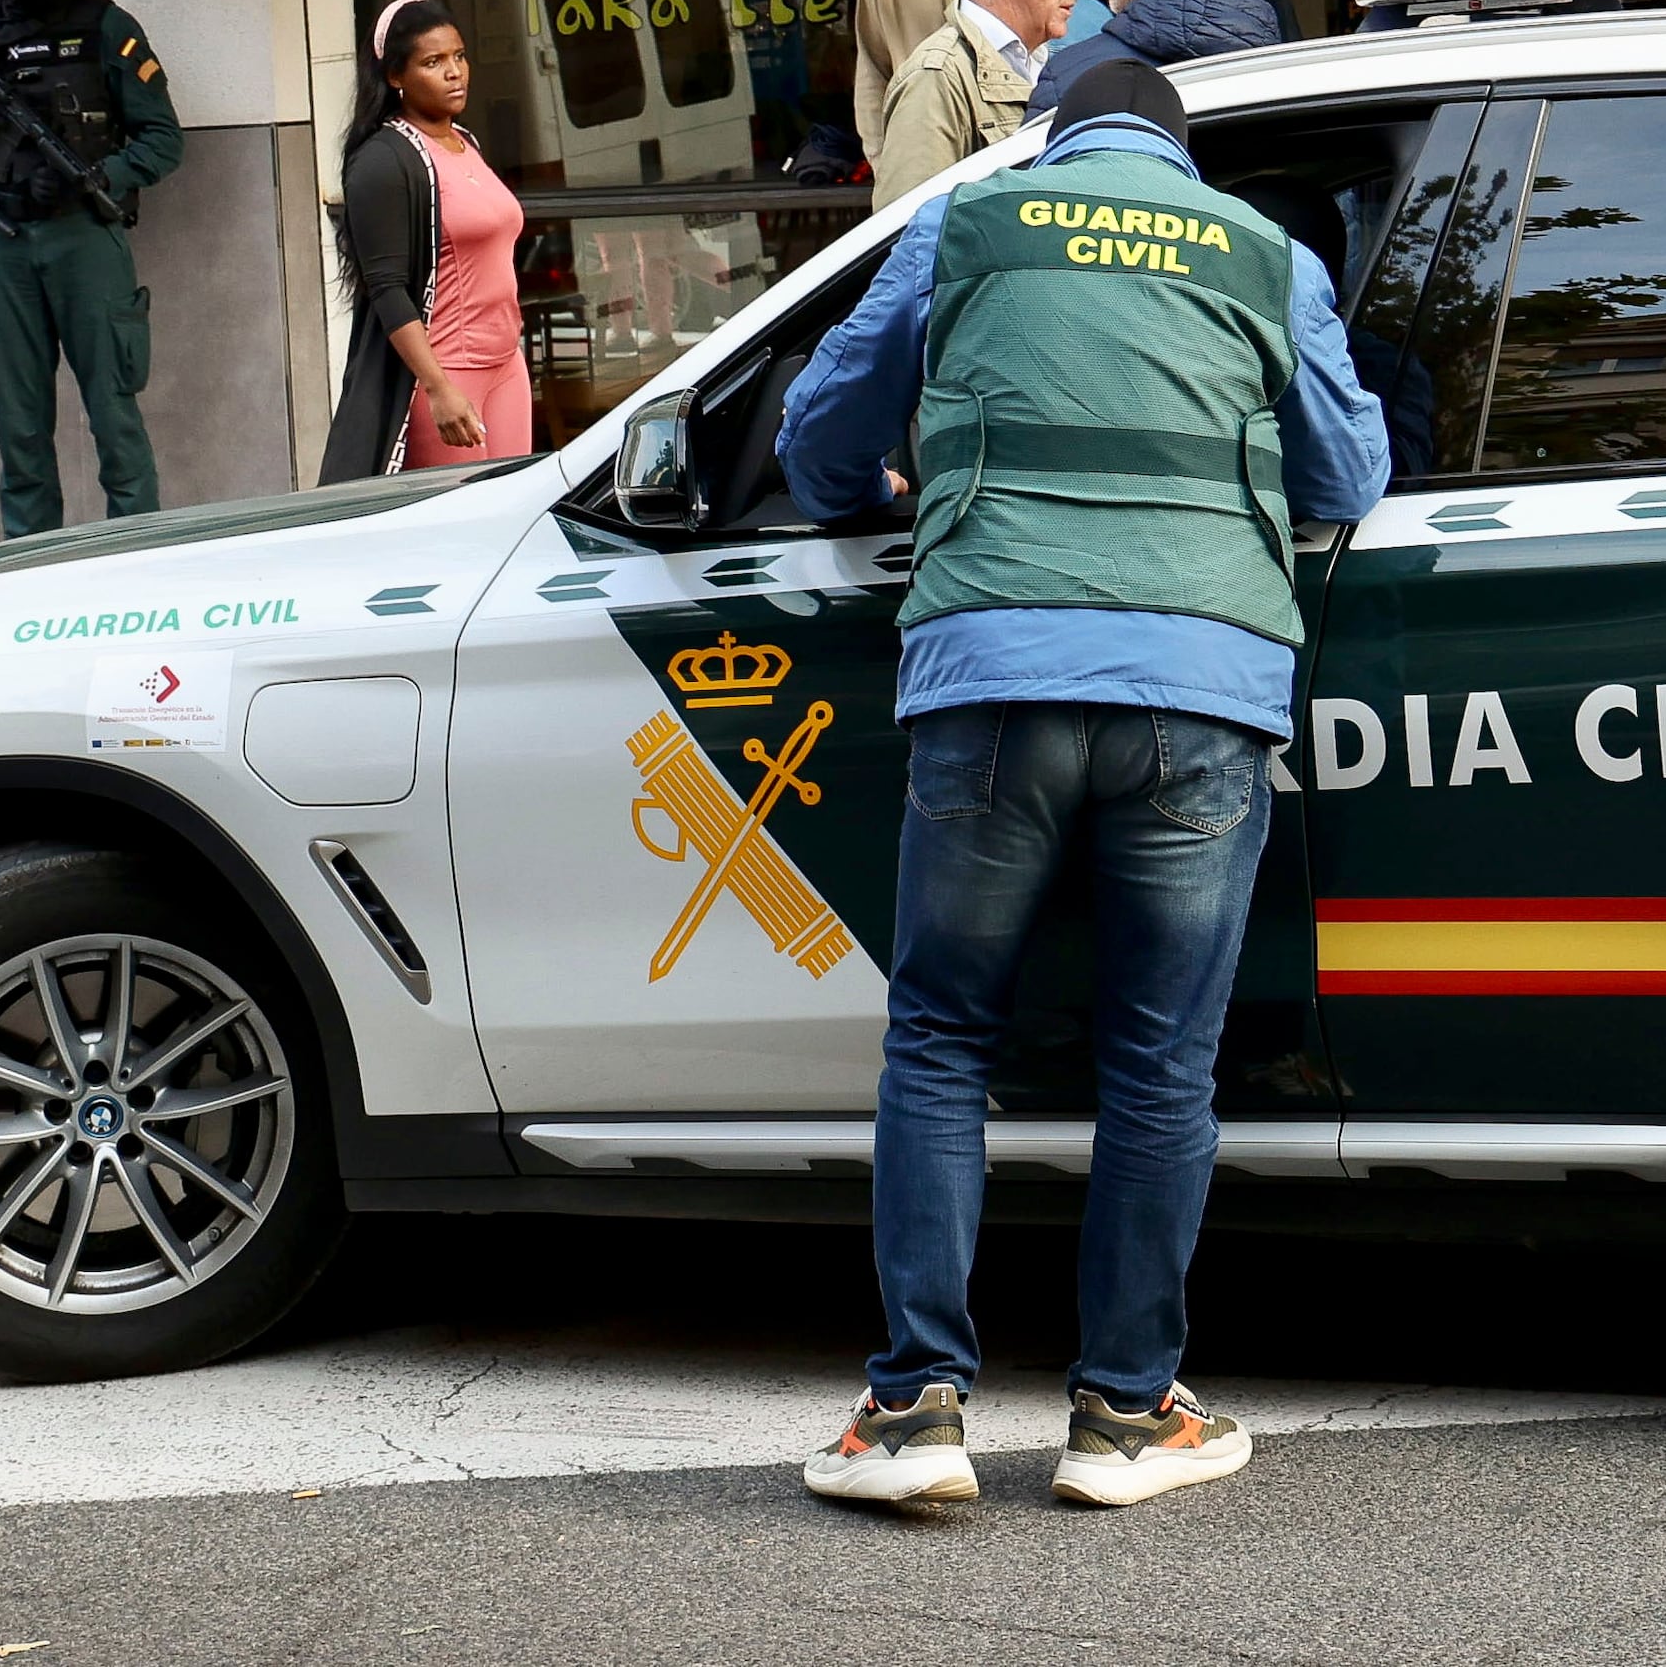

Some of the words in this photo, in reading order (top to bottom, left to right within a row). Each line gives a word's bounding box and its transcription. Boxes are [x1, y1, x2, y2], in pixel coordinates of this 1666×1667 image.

[1019, 199, 1231, 253] GUARDIA
[1066, 235, 1190, 275] CIVIL
[14, 608, 180, 642] GUARDIA
[203, 598, 299, 629] CIVIL
